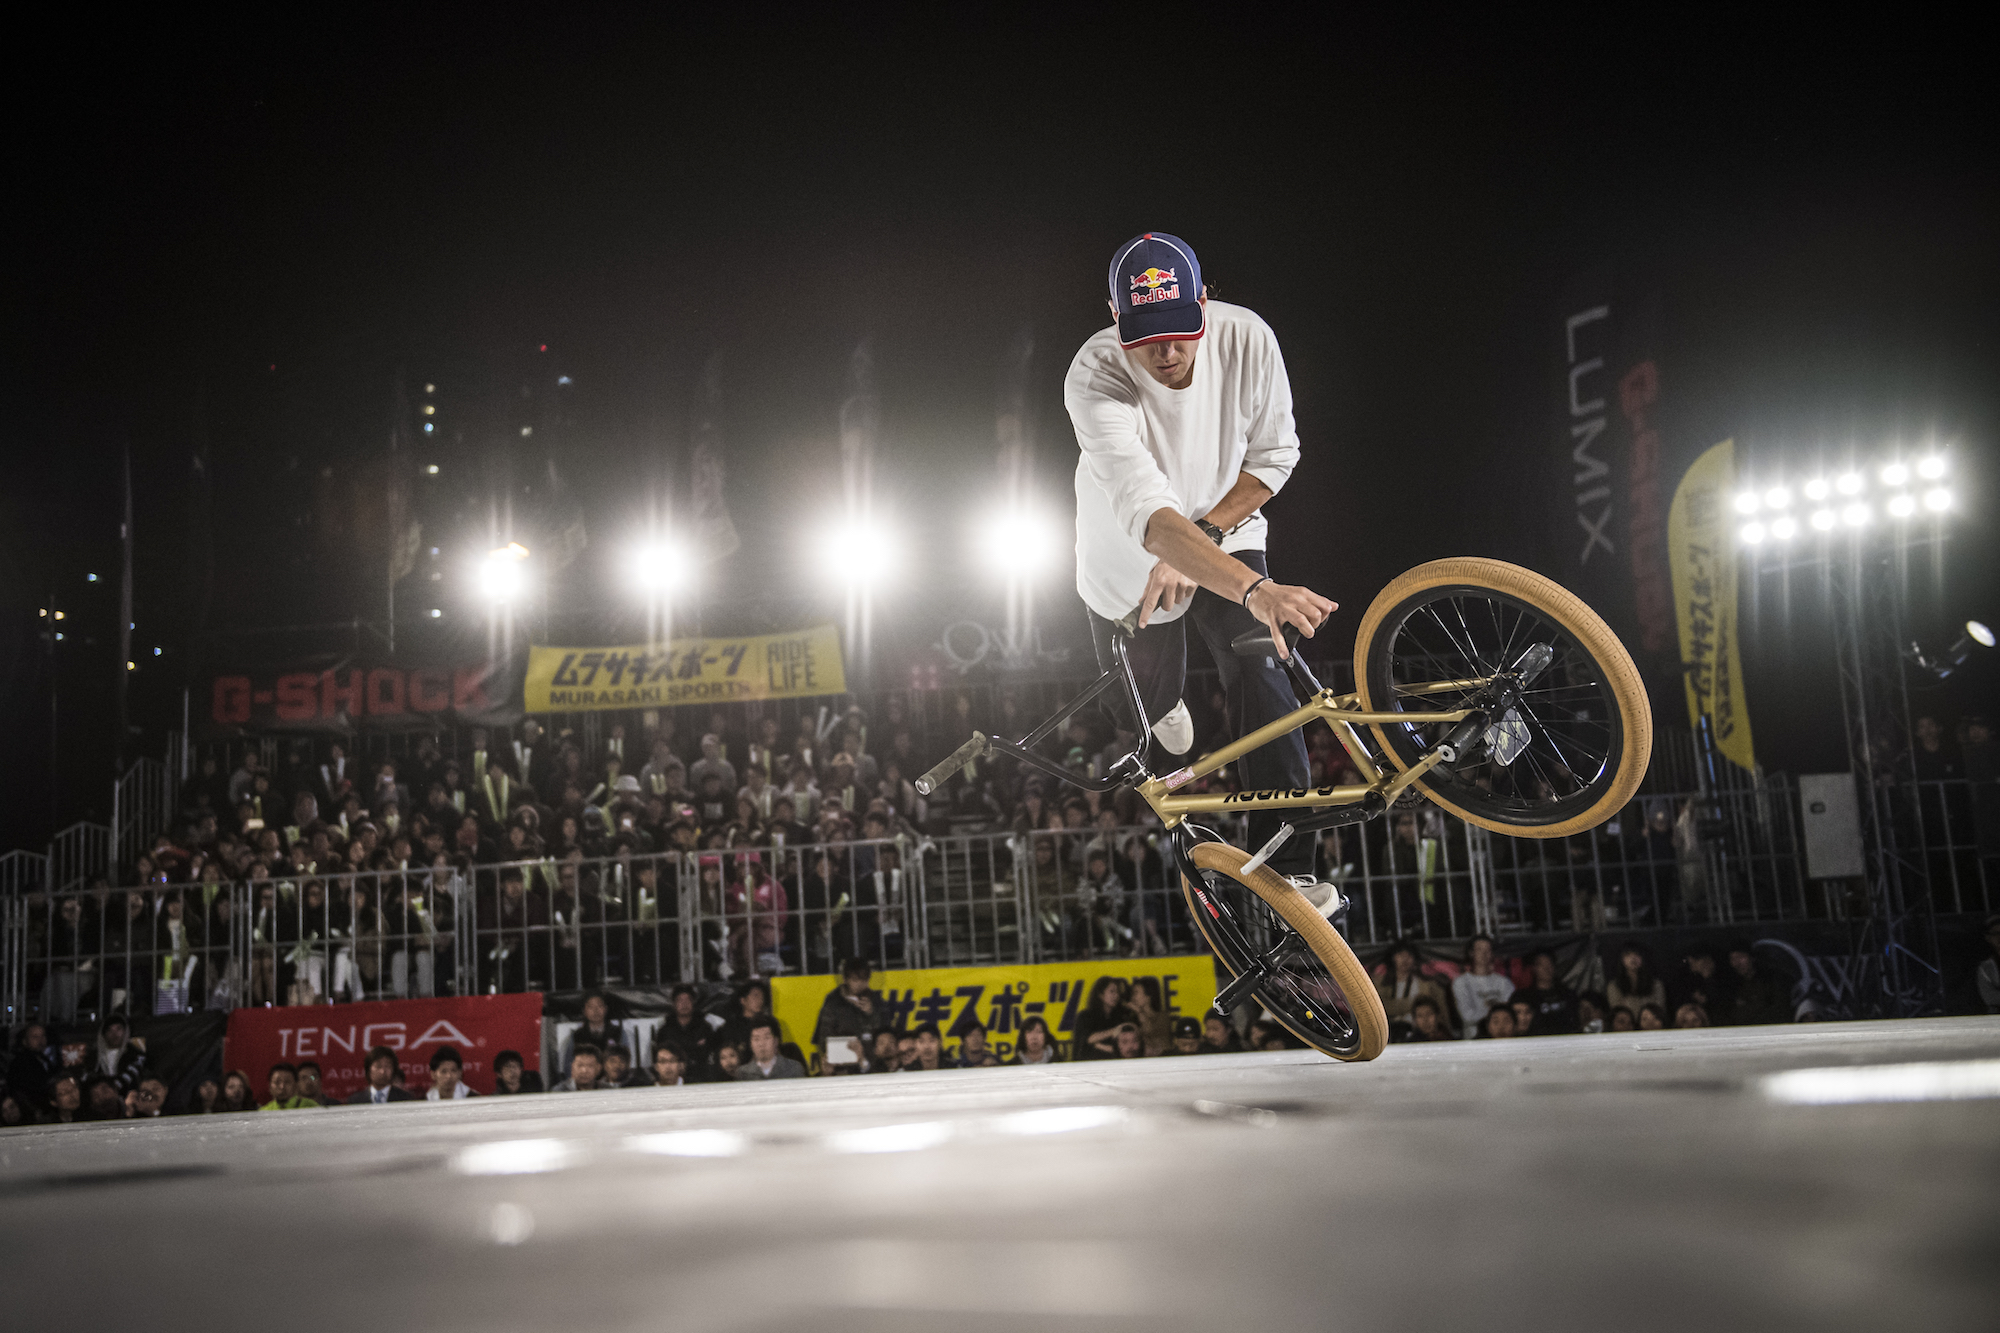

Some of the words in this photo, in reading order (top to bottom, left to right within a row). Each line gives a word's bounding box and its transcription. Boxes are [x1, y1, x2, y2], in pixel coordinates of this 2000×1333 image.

[1132, 289, 1155, 305] Red
[1155, 285, 1179, 301] Bull
[1567, 305, 1614, 563] LUMIX
[552, 644, 749, 688] ムラサキスポーツ
[766, 637, 812, 664] RIDE
[767, 660, 819, 693] LIFE
[212, 667, 489, 724] G-SHOCK
[550, 687, 661, 707] MURASAKI
[667, 680, 750, 702] SPORTS
[278, 1020, 475, 1057] TENGA
[326, 1067, 365, 1080] ADU
